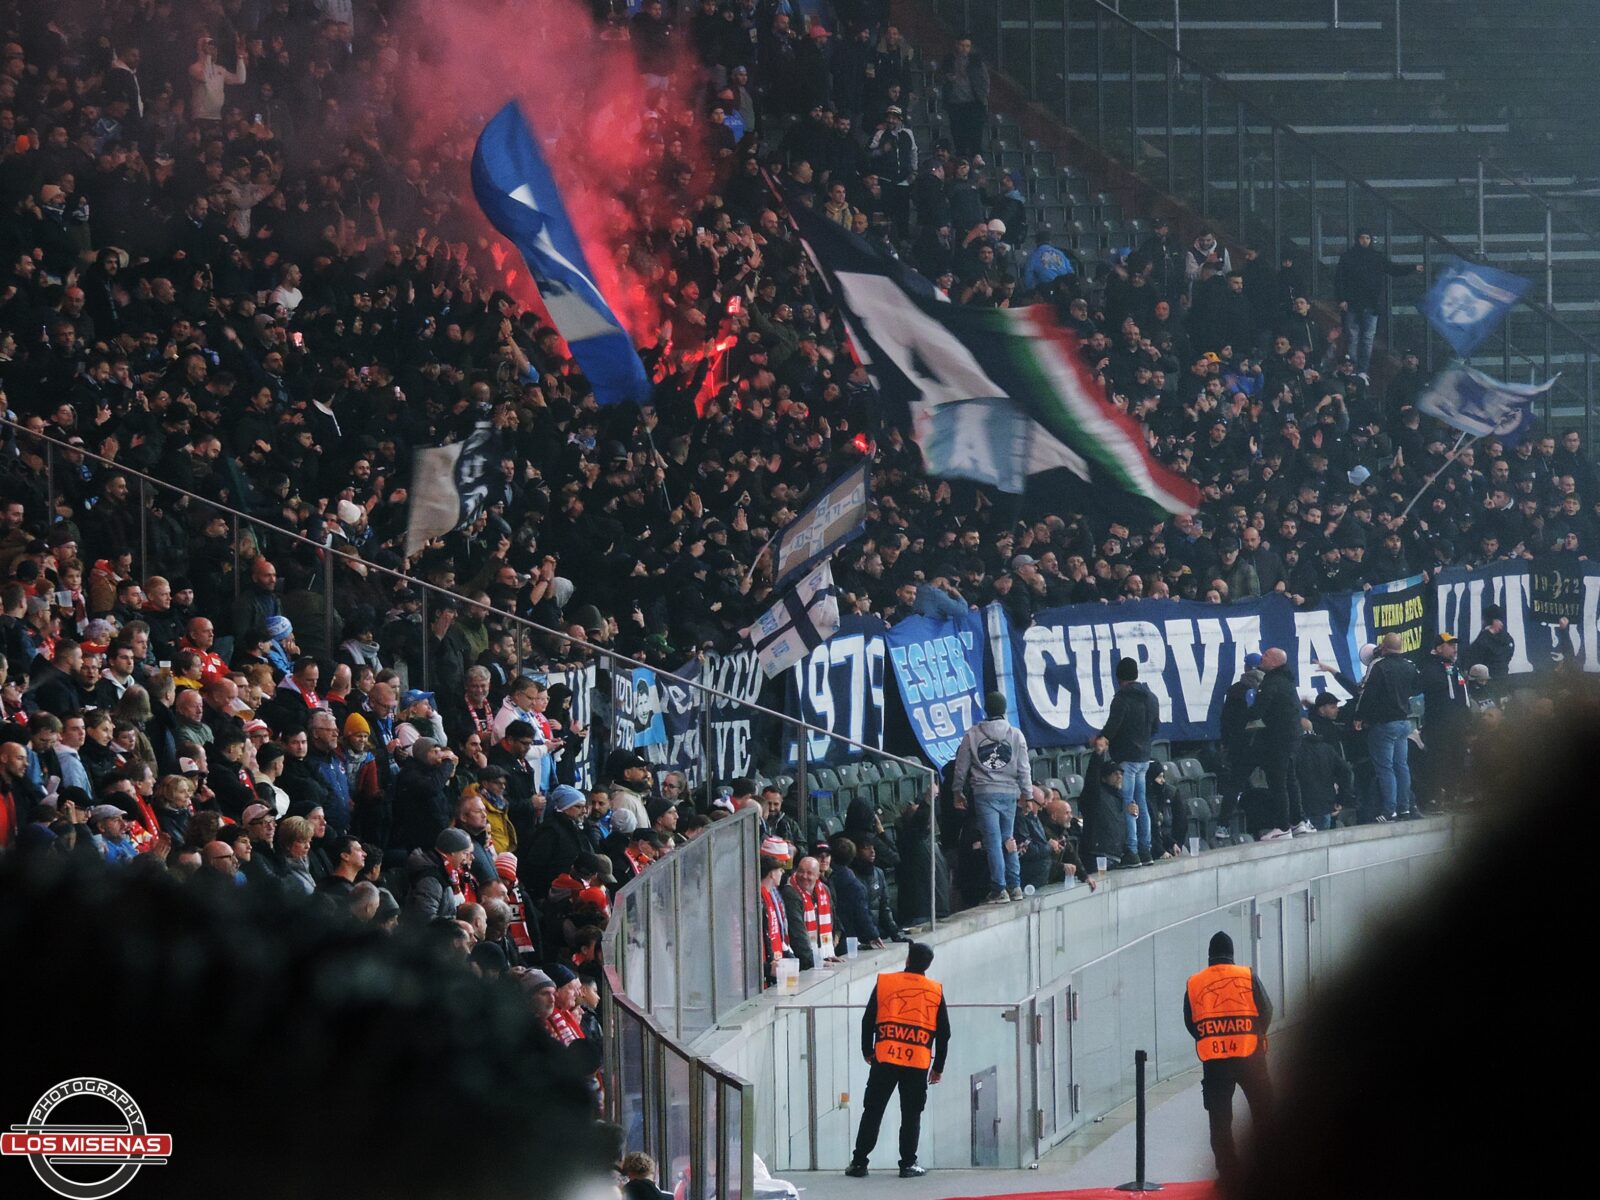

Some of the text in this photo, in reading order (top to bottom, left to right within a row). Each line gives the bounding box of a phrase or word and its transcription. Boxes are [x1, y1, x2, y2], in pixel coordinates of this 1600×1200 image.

[1023, 609, 1354, 730] CURVA A
[886, 1045, 915, 1062] 419
[1211, 1040, 1238, 1055] 814
